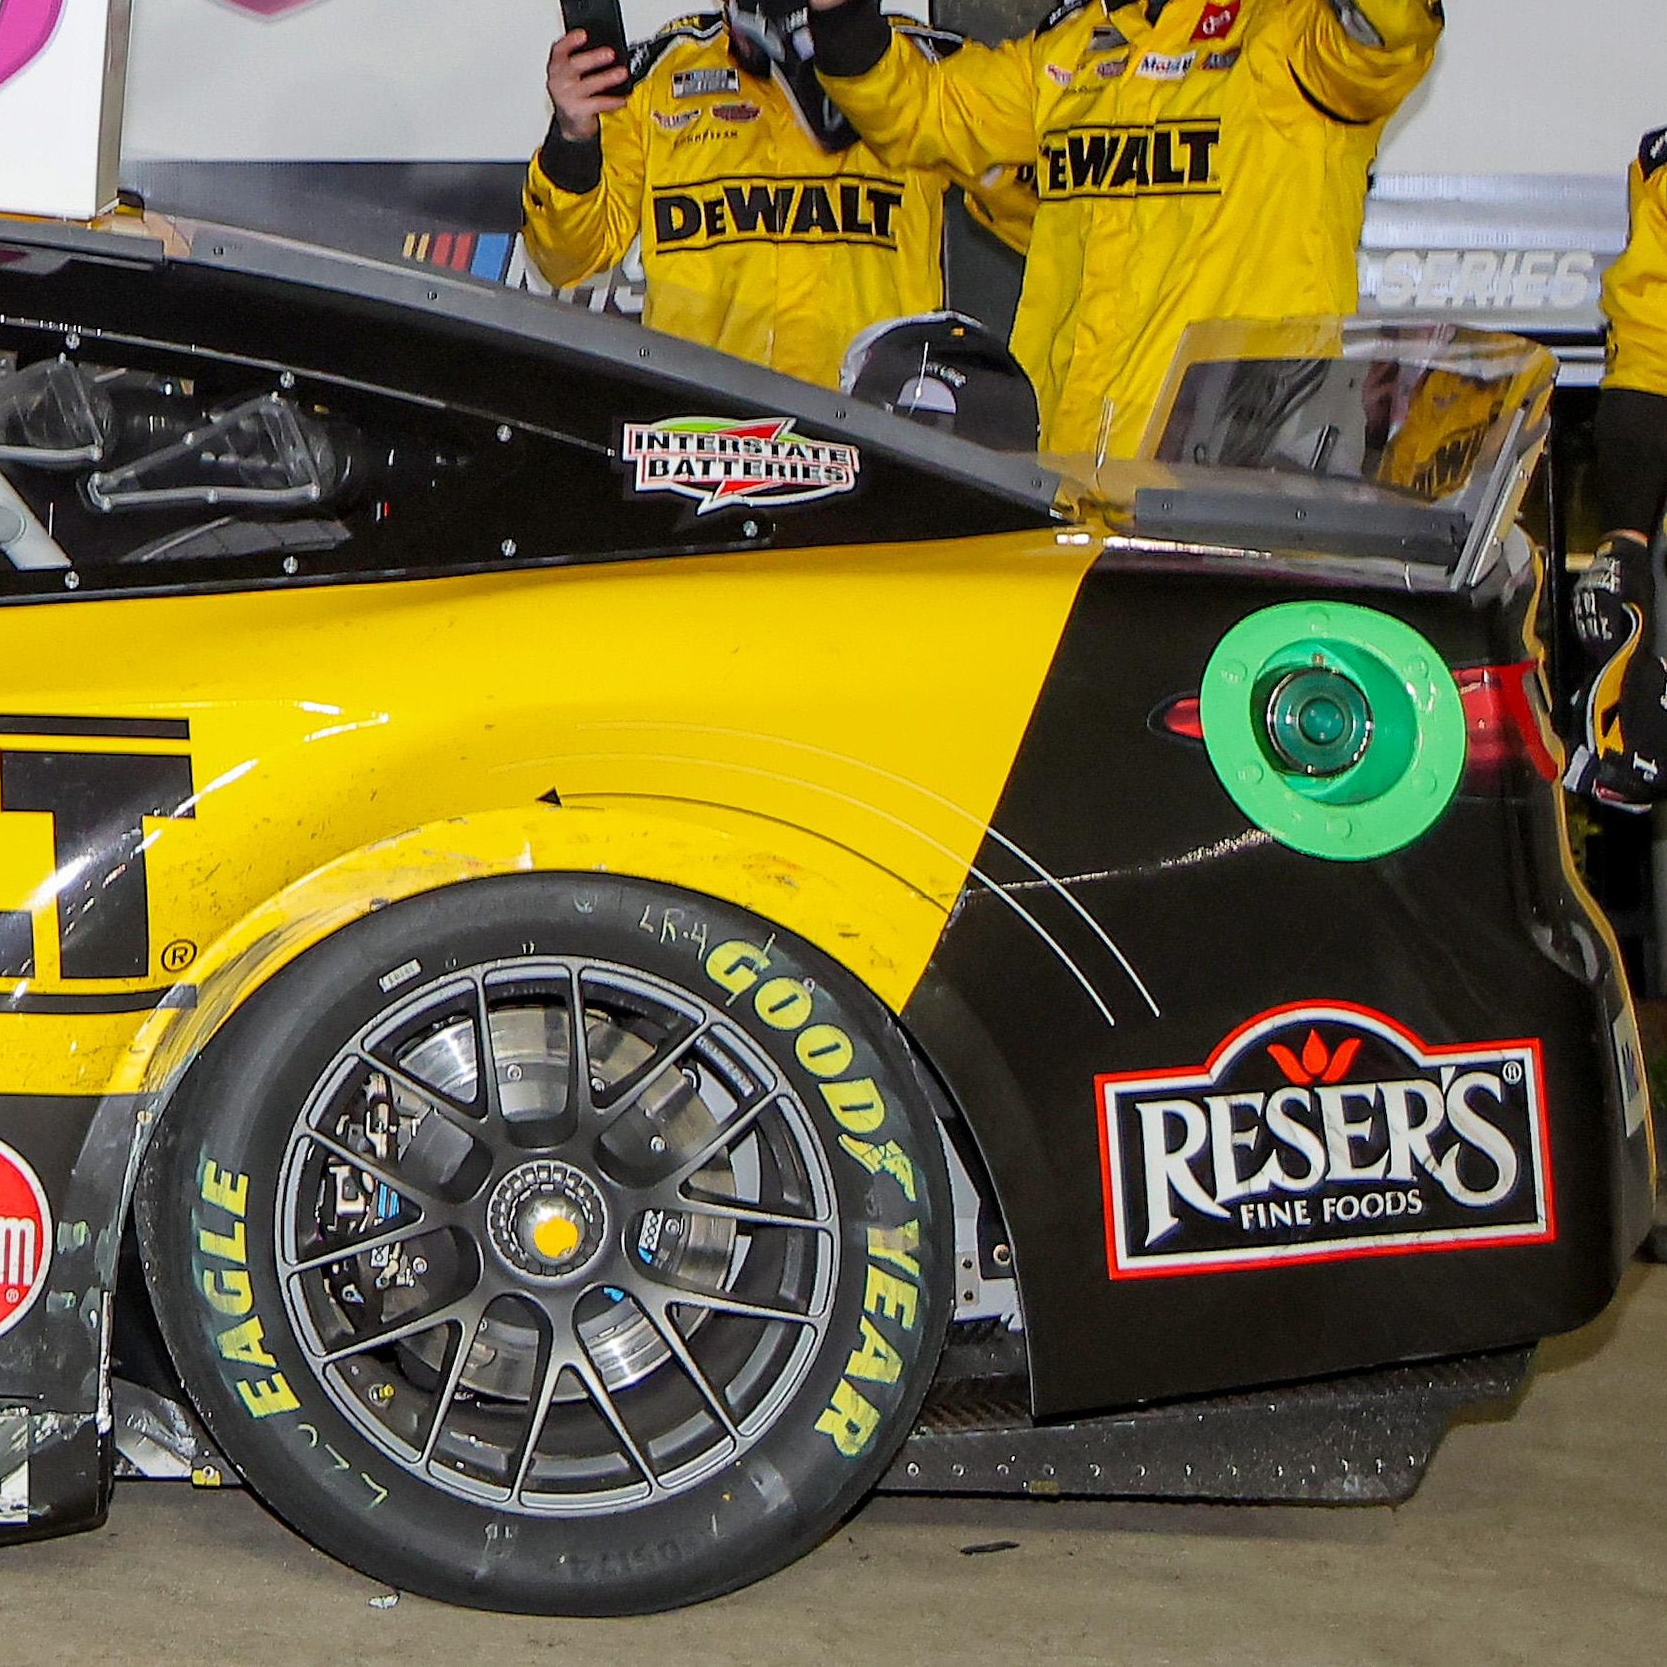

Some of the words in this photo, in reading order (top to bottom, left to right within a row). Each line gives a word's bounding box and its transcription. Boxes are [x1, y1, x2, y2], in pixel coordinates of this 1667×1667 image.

[1047, 131, 1220, 190] EWALT
[651, 185, 902, 244] DEWALT
[1378, 248, 1597, 311] SERIES
[634, 431, 851, 462] INTERSTATE
[648, 459, 846, 483] BATTERIES
[1136, 1065, 1521, 1249] RESER'S
[703, 937, 923, 1459] GOODYEAR
[1240, 1198, 1311, 1231] FINE
[1323, 1189, 1423, 1222] FOODS
[197, 1158, 301, 1419] EAGLE
